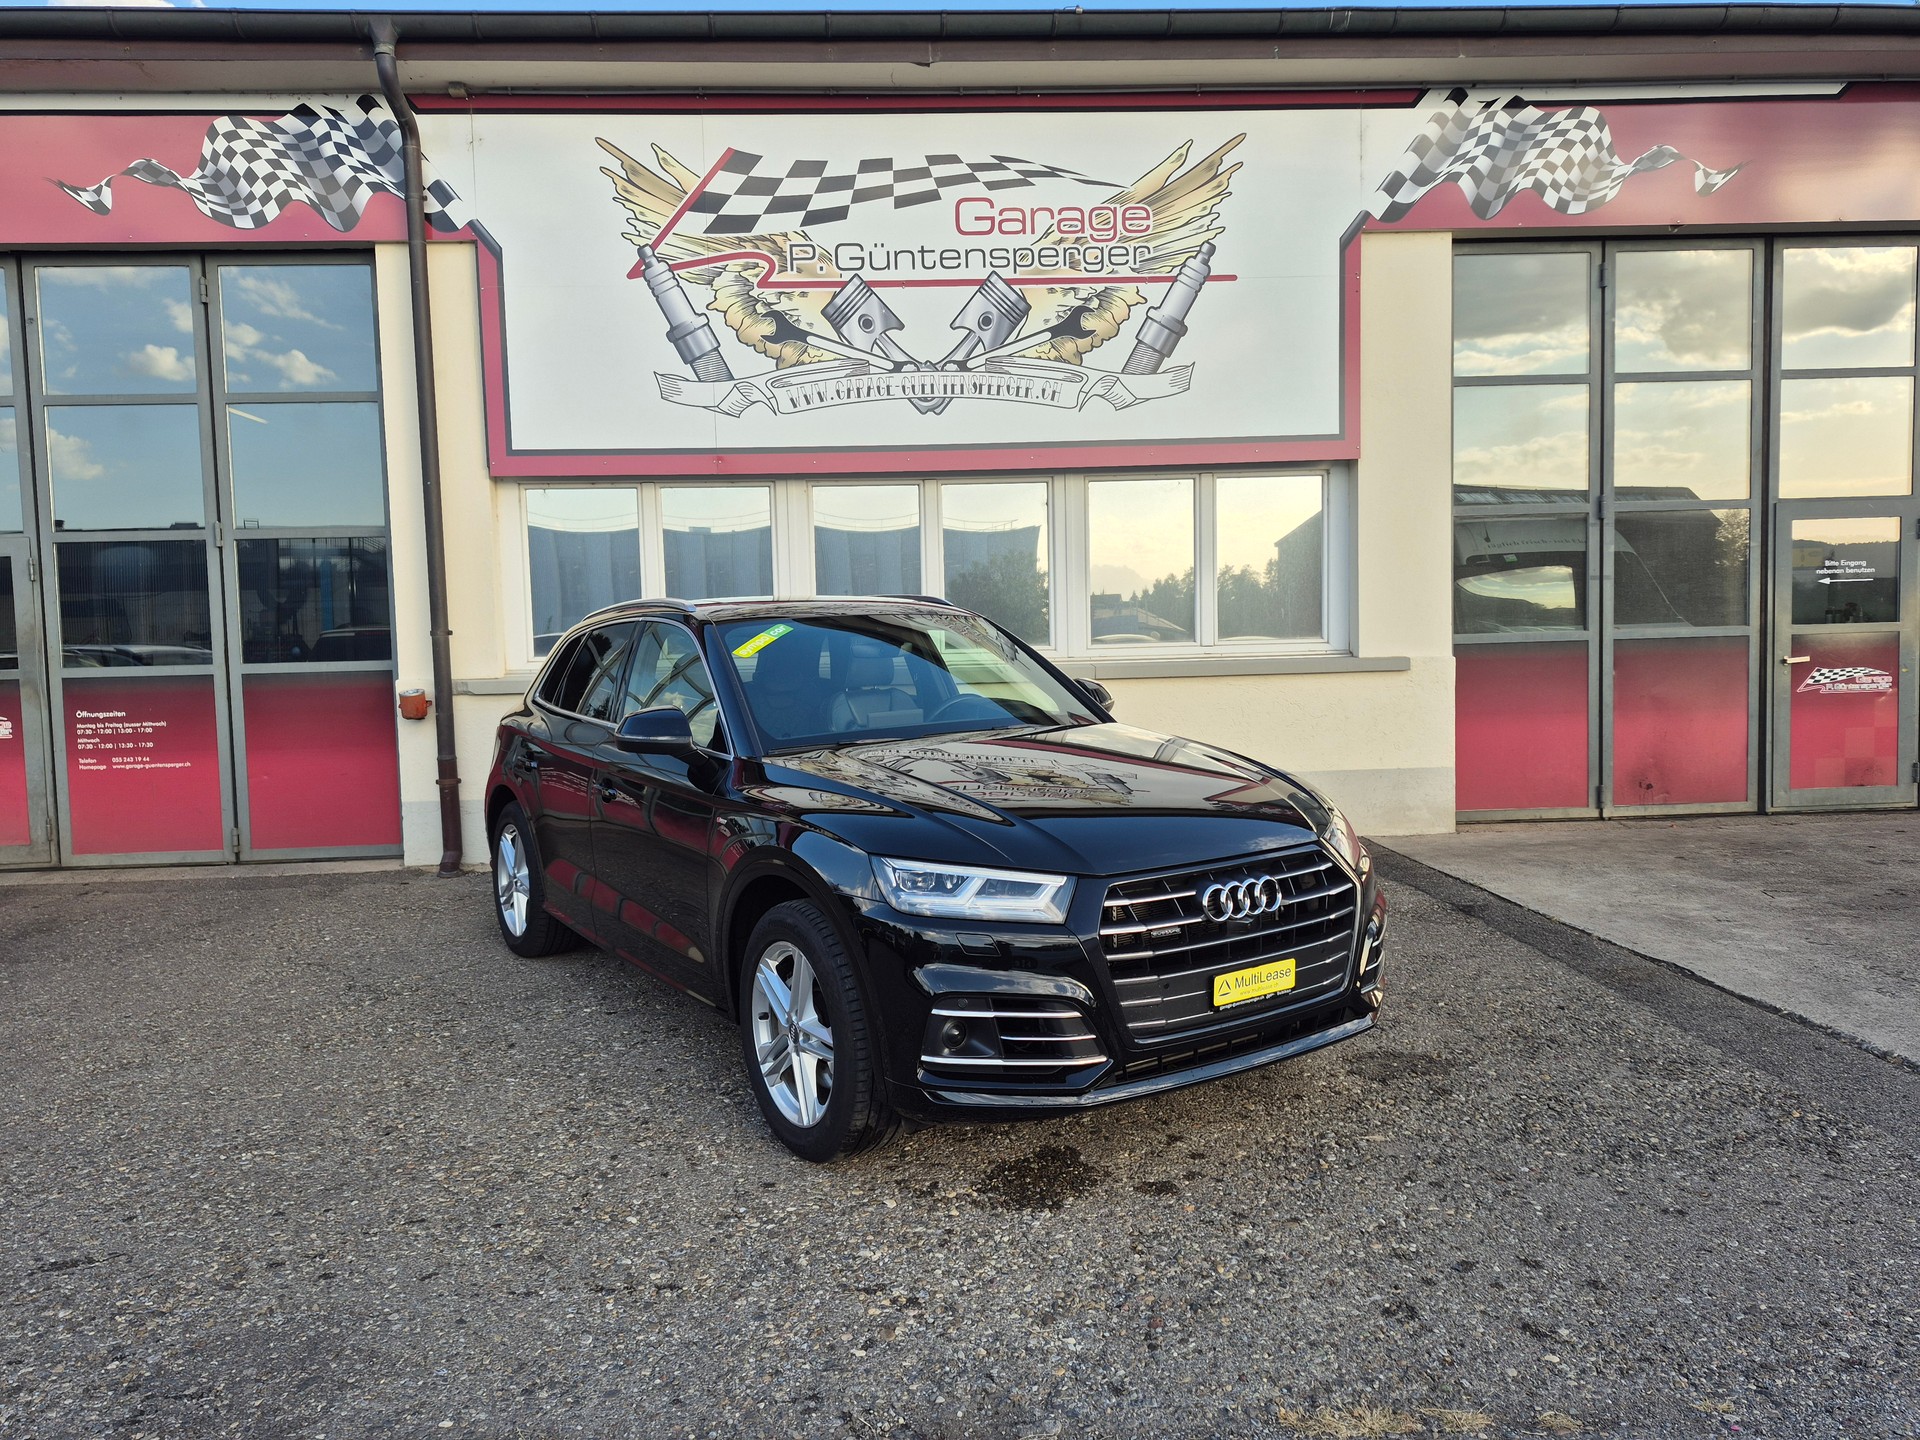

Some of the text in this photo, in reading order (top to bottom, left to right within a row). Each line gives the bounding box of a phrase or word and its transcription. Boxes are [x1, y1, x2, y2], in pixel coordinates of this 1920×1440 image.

[954, 196, 1151, 243] Garage
[789, 242, 1151, 273] P. Güntensperger
[785, 375, 1064, 409] WWW.GARAGE-GUENTENSPERGER.CH
[1840, 559, 1867, 567] Eingang
[1816, 567, 1844, 575] nebenan
[769, 625, 786, 636] car
[75, 710, 126, 719] Öffnungszeiten
[112, 762, 191, 770] www.garage-guentensperger.ch
[1234, 967, 1292, 989] MultiLease
